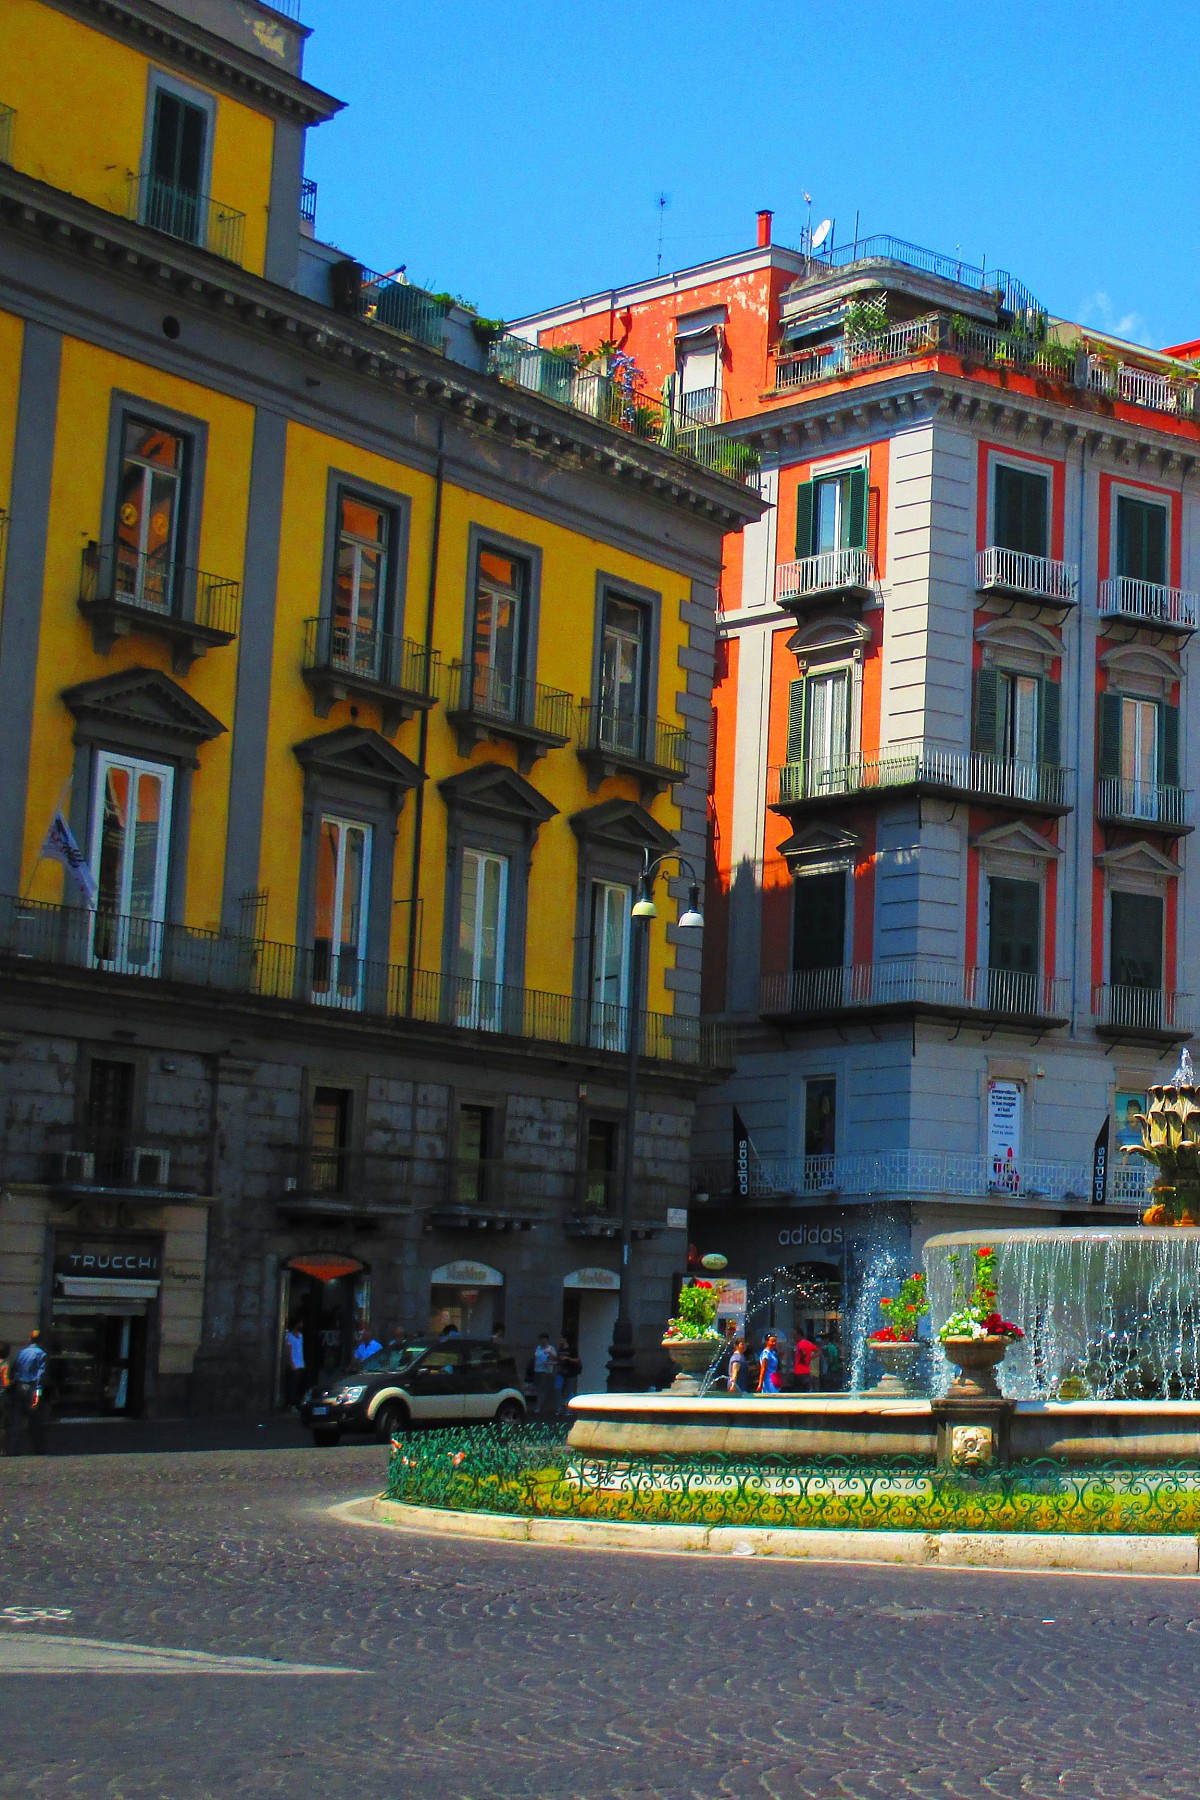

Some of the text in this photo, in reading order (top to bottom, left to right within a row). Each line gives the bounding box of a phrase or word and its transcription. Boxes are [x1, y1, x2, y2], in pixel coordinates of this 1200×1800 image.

[737, 1140, 748, 1195] adidas
[1095, 1147, 1106, 1202] adidas
[778, 1224, 843, 1246] adidas
[70, 1255, 156, 1268] TRUCCHI
